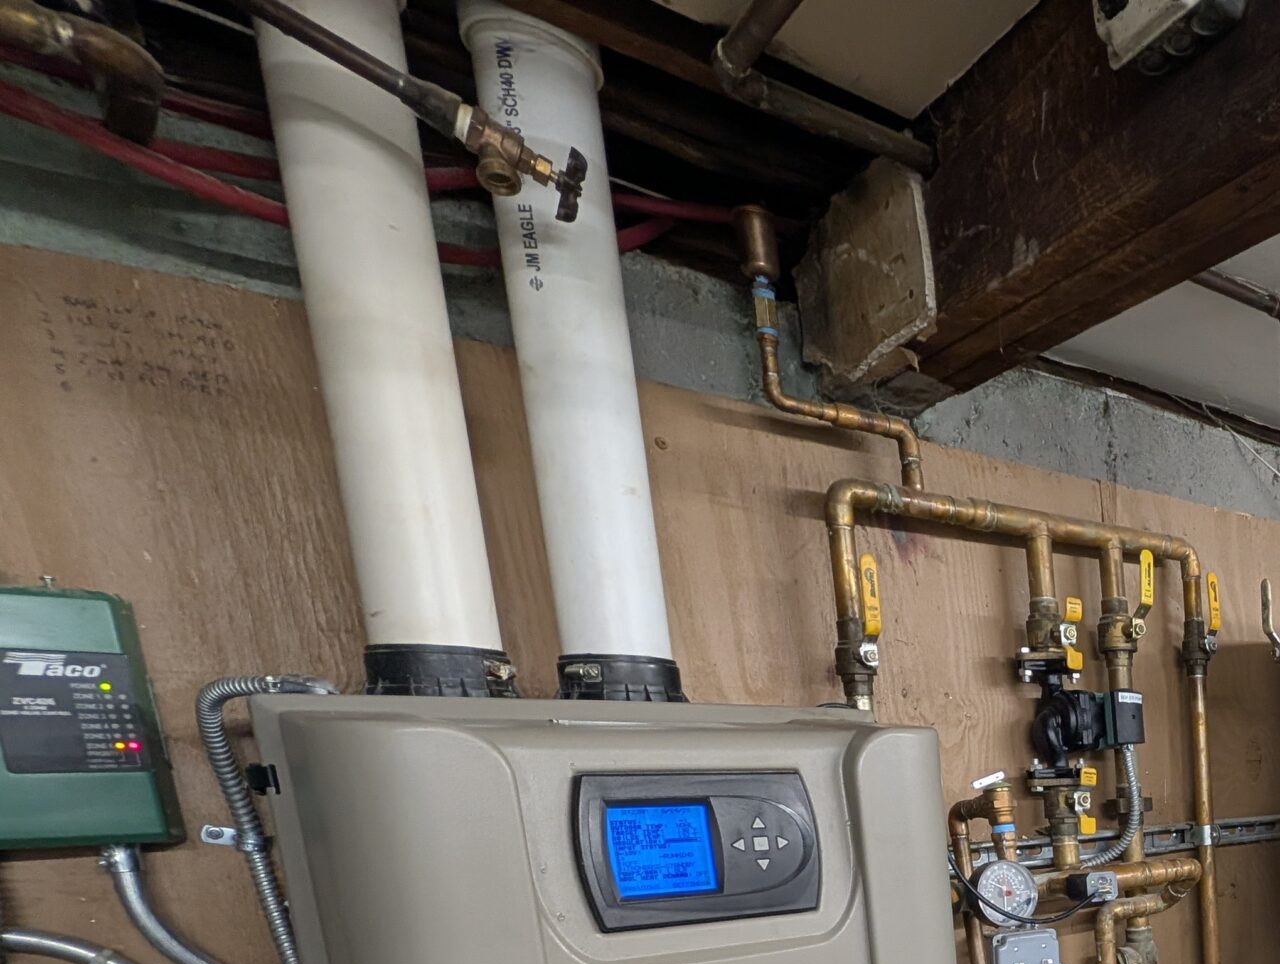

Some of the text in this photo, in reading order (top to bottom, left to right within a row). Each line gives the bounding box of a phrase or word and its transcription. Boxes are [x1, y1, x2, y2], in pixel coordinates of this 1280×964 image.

[499, 73, 519, 118] SCH40
[518, 203, 539, 250] EAGLE
[527, 253, 541, 272] JM
[3, 651, 101, 678] Taco
